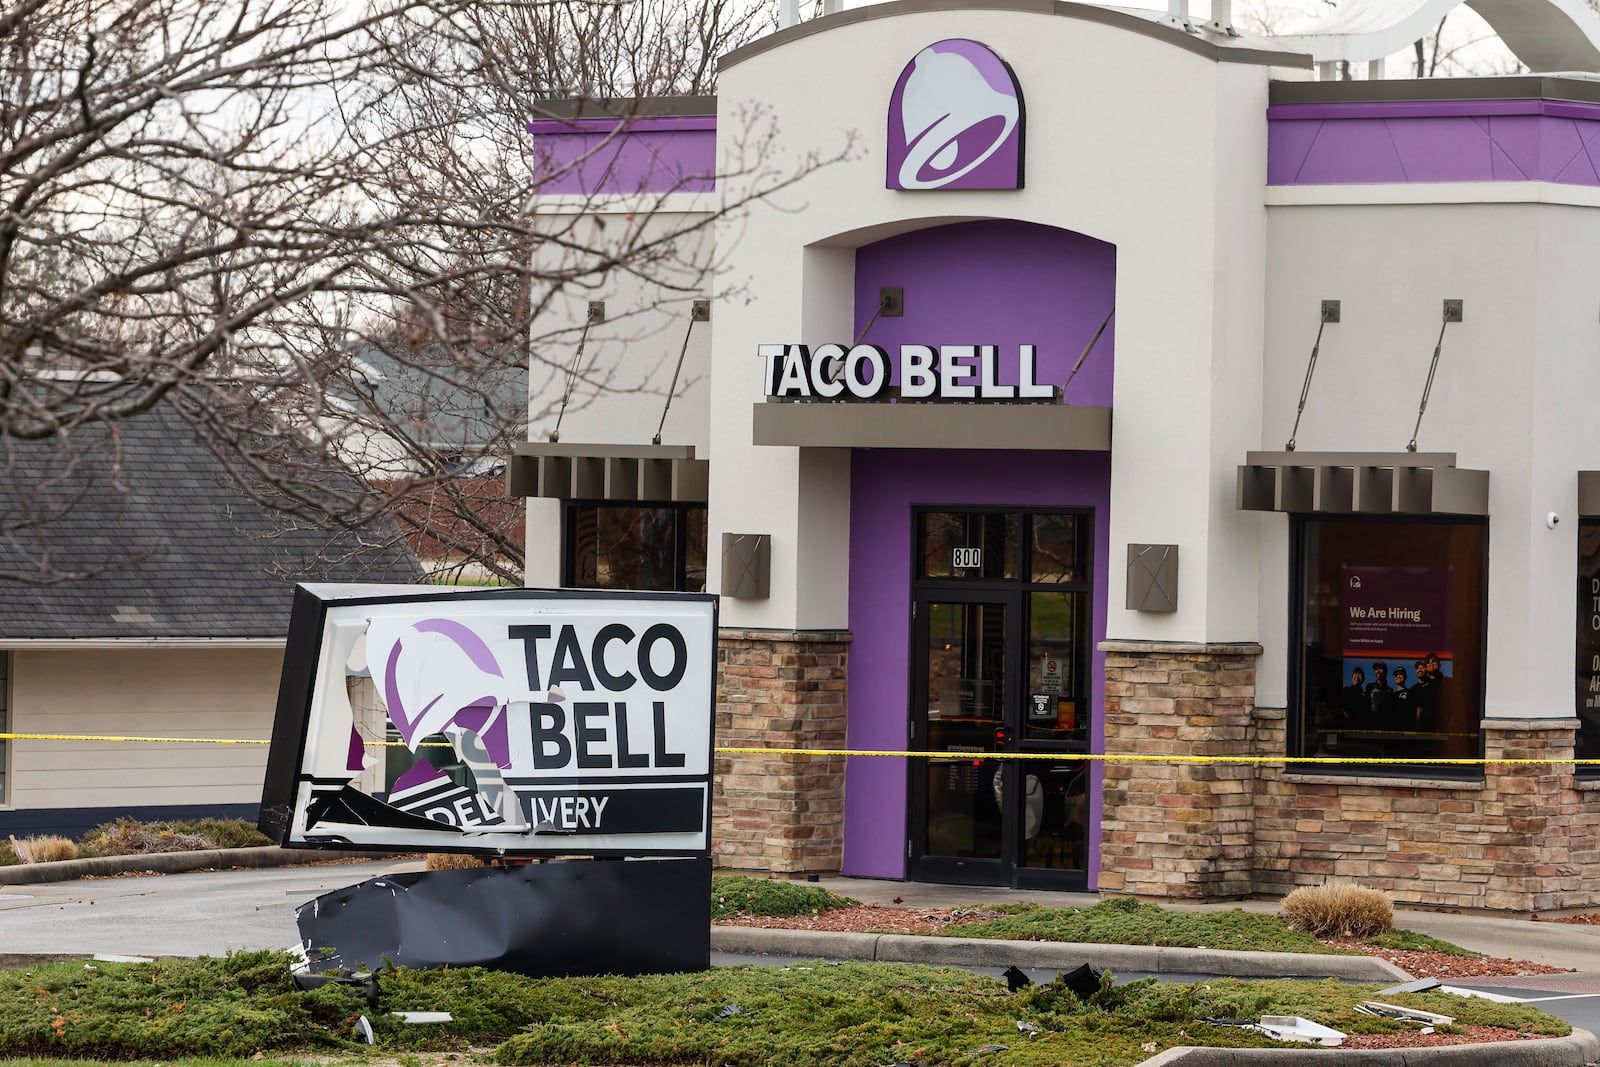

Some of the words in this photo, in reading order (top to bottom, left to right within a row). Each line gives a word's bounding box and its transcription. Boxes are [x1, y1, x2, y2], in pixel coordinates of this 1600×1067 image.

[758, 343, 886, 398] TACO
[901, 343, 1054, 398] BELL
[954, 549, 980, 566] 800
[1350, 606, 1366, 618] We
[1367, 607, 1386, 619] Are
[1388, 607, 1421, 622] Hiring
[508, 623, 687, 691] TACO
[529, 702, 686, 770] BELL
